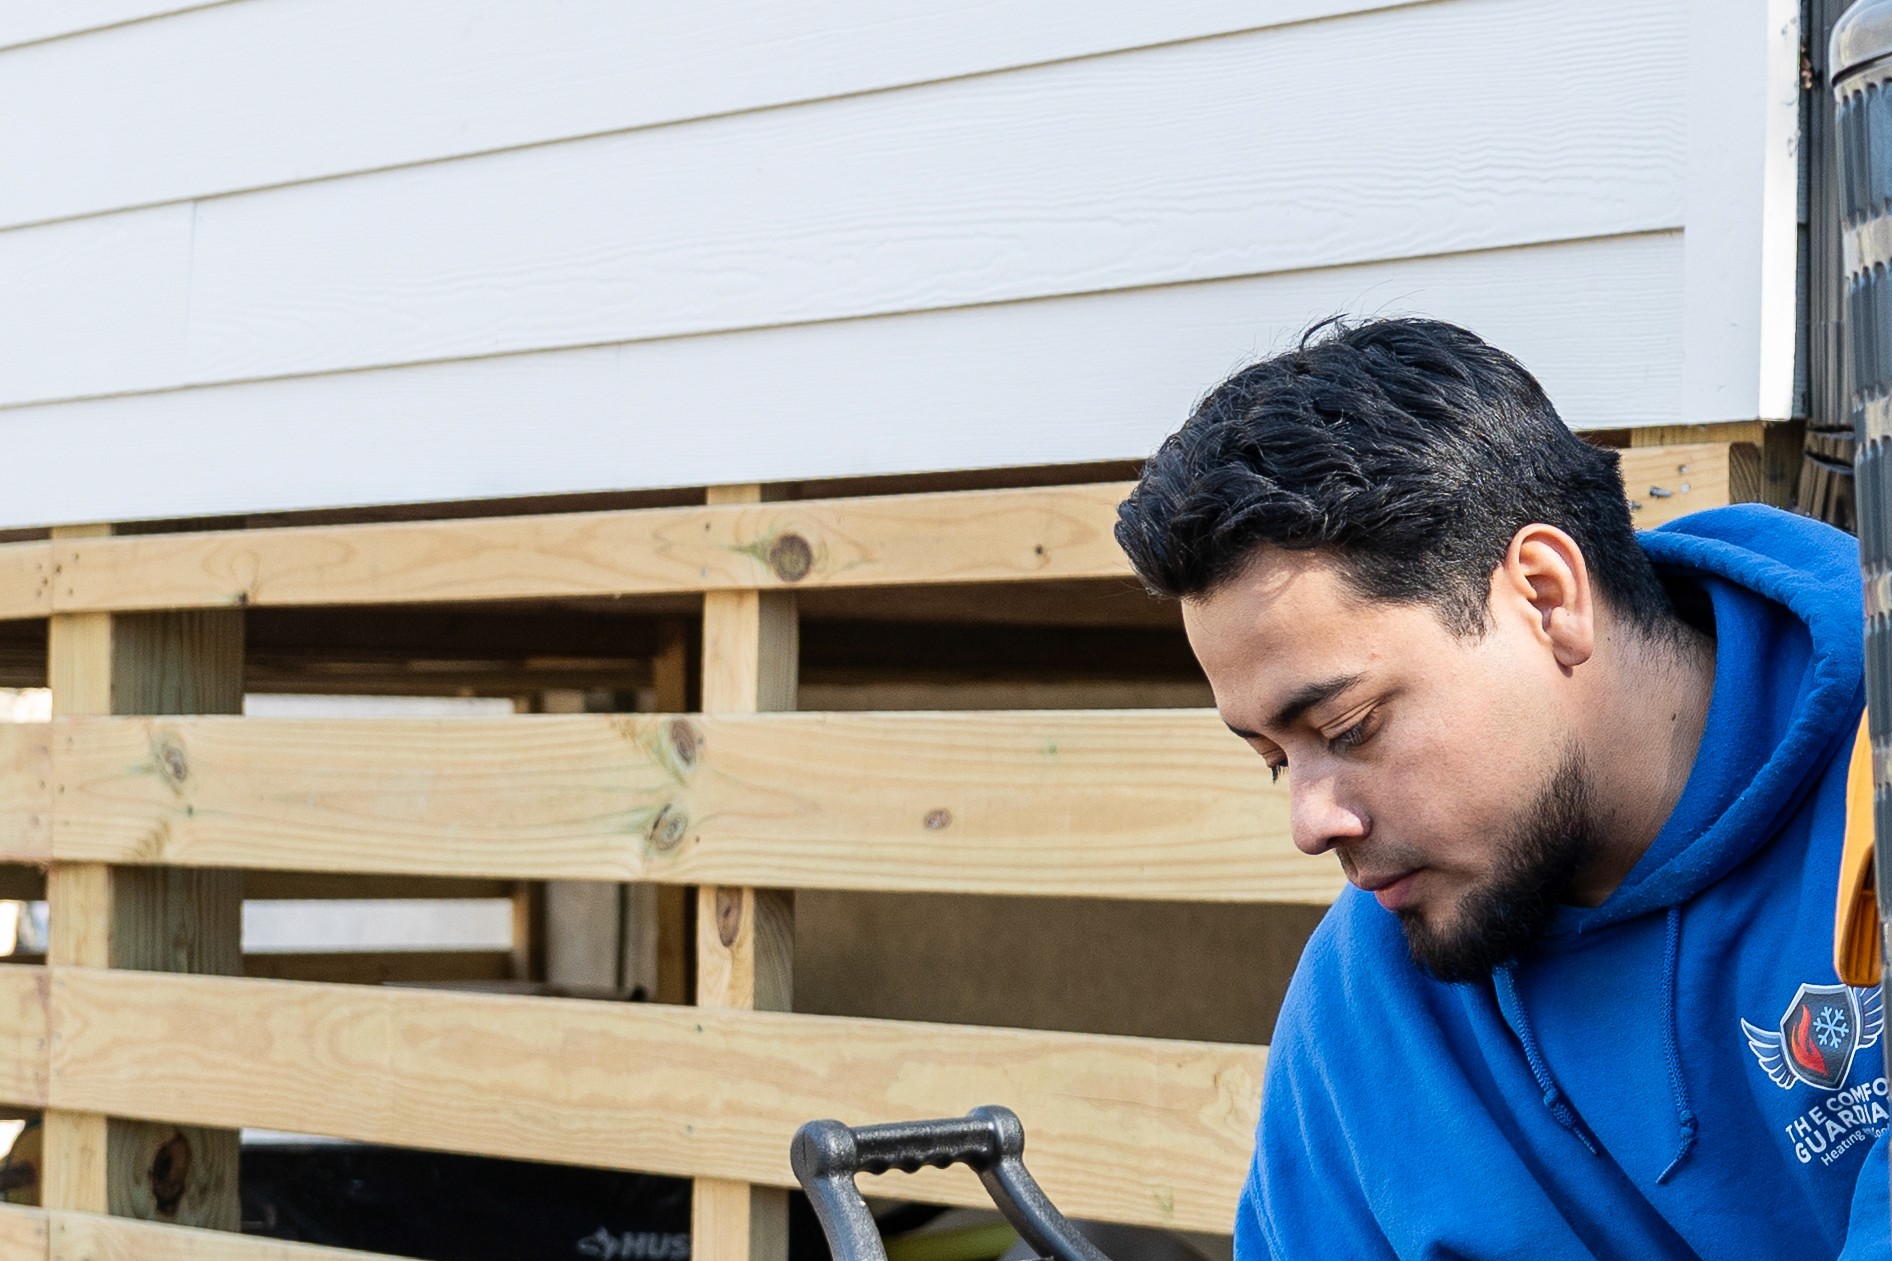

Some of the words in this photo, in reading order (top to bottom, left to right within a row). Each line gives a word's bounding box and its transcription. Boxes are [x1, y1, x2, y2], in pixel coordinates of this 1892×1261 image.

[1785, 1105, 1828, 1144] THE
[1826, 1077, 1889, 1111] COMFO
[1795, 1101, 1890, 1164] GUARDIA
[1820, 1129, 1867, 1167] Heating
[621, 1231, 690, 1261] HUS
